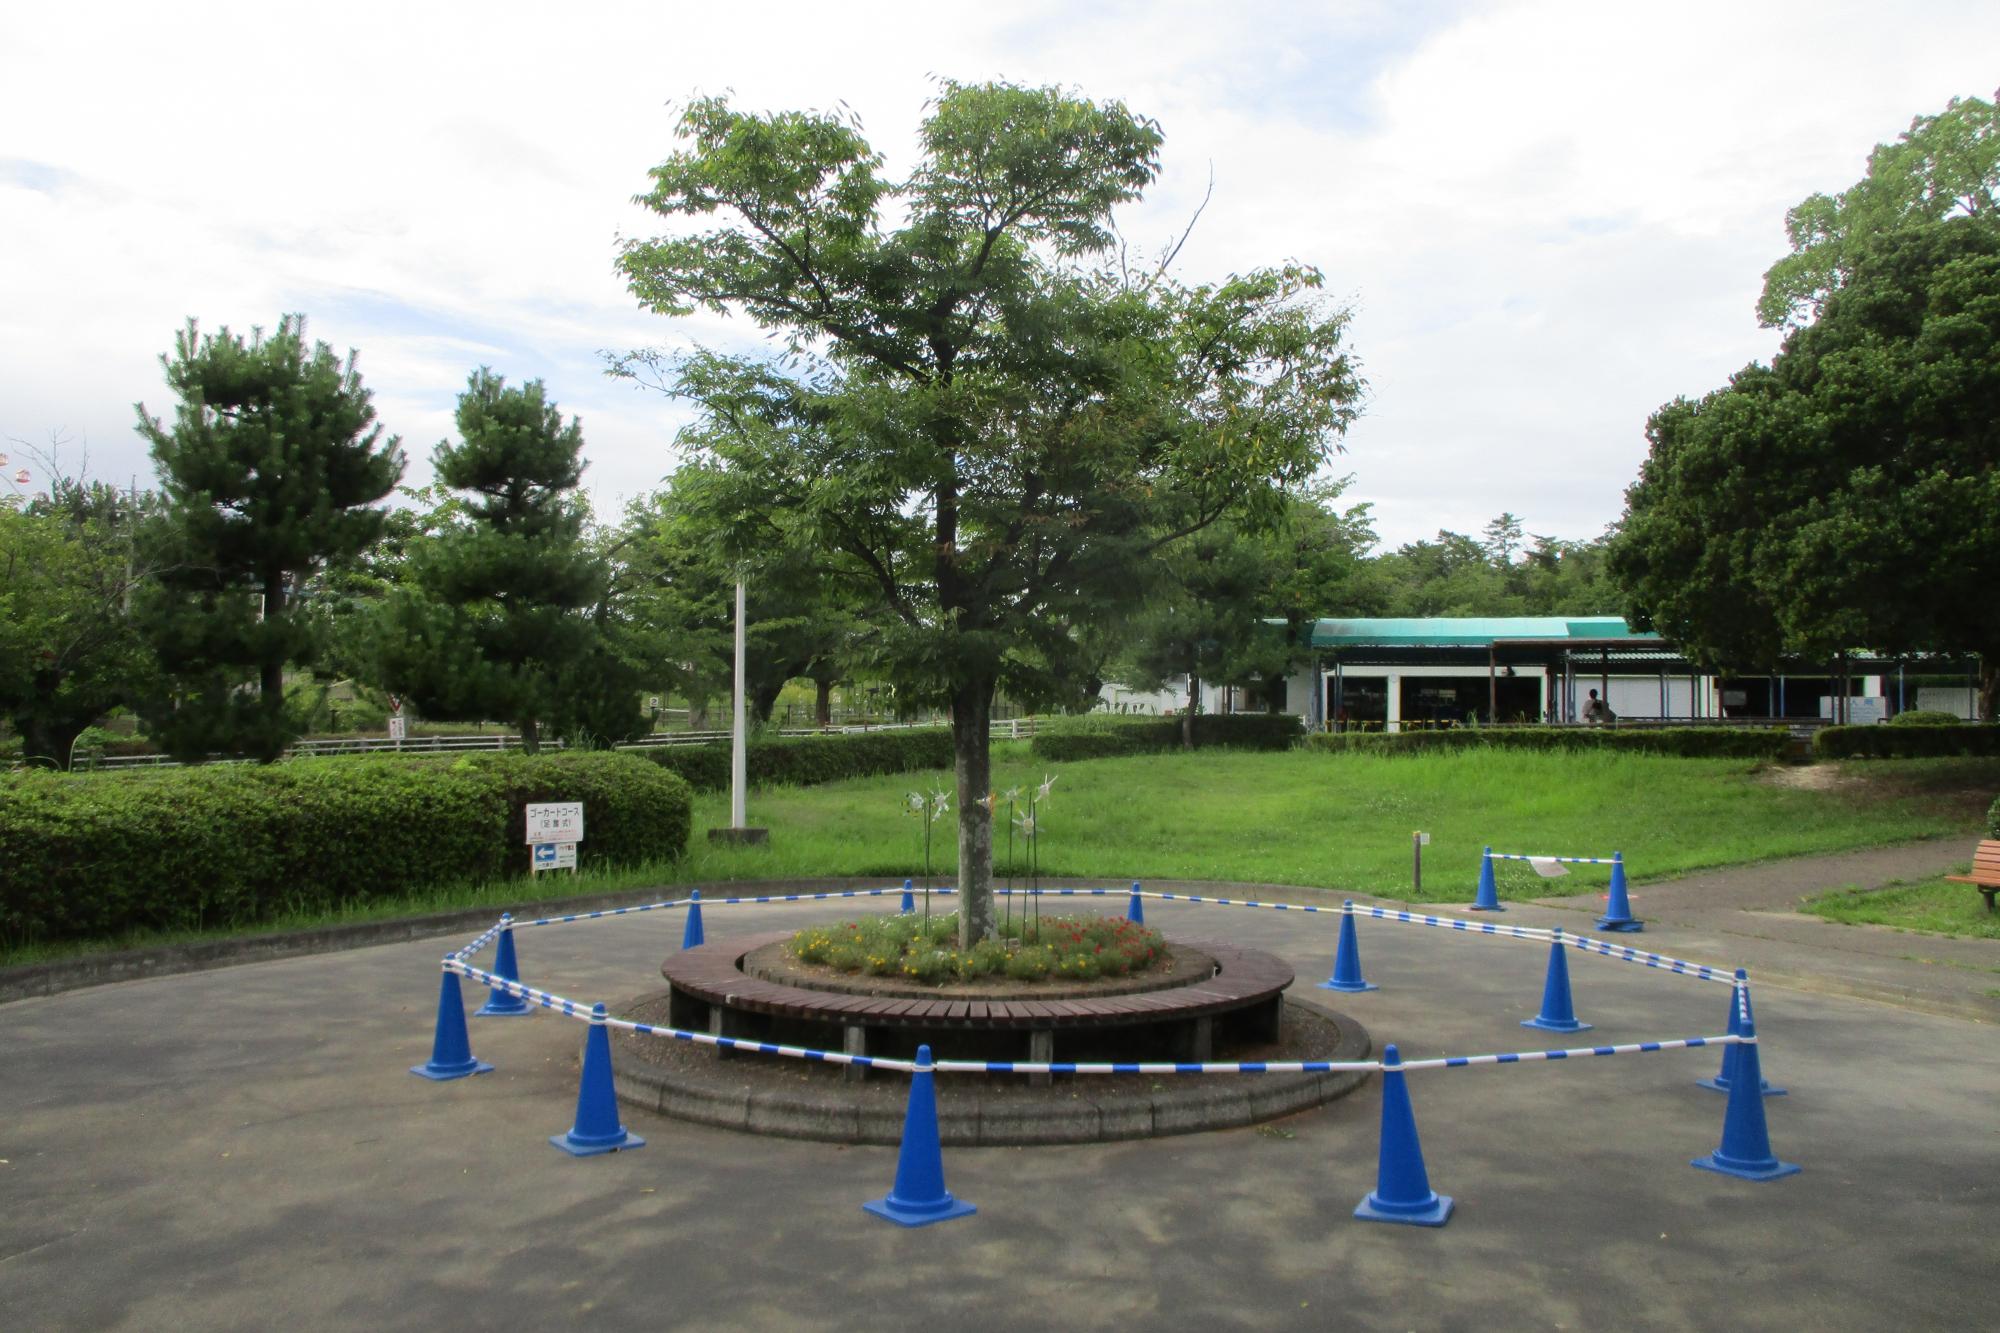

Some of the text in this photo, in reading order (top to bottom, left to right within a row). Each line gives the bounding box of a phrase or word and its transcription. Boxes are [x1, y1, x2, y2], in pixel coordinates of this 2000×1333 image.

[529, 807, 580, 818] ゴーカートコース
